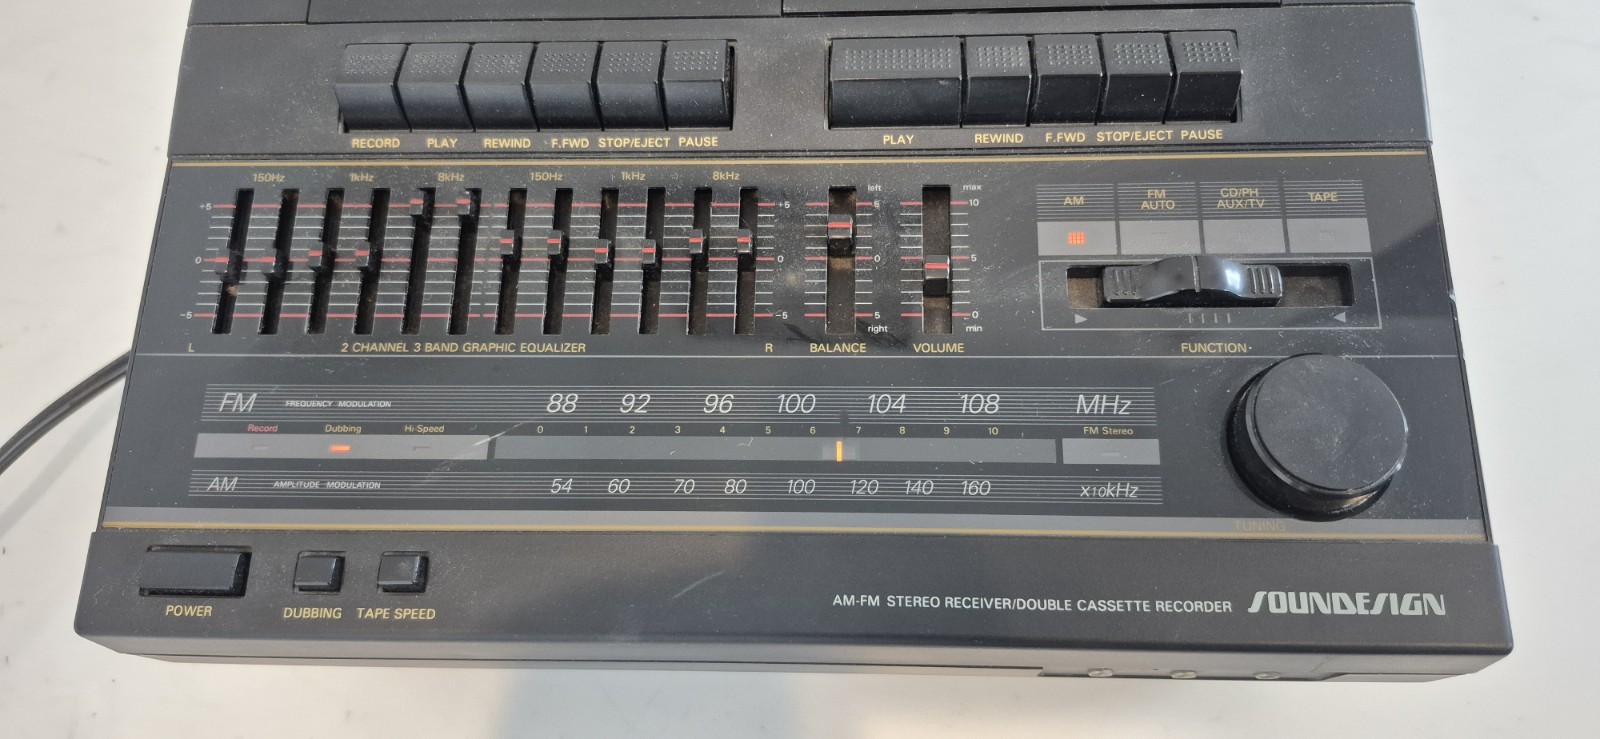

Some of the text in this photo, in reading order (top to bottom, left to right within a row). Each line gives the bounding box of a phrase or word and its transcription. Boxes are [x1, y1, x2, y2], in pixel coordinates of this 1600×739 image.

[882, 134, 914, 145] PLAY
[974, 133, 1024, 144] REWIND
[1045, 132, 1086, 143] F.FWD
[1096, 130, 1173, 142] STOP/EJECT
[1180, 129, 1223, 140] PAUSE
[351, 138, 401, 149] RECORD
[427, 138, 458, 149] PLAY
[483, 138, 531, 149] REWIND
[551, 138, 590, 149] F.FWD
[598, 137, 670, 149] STOP/EJECT
[678, 136, 719, 148] PAUSE
[252, 172, 285, 183] 150Hz
[350, 172, 374, 183] 1kHz
[437, 172, 465, 183] 8kHz
[529, 171, 563, 182] 150Hz
[621, 171, 646, 182] 1kHz
[712, 171, 740, 181] 8kHz
[868, 184, 882, 192] left
[963, 184, 982, 192] max
[1220, 187, 1259, 198] CD/PH
[1147, 189, 1166, 199] FM
[1308, 191, 1338, 202] TAPE
[199, 202, 212, 211] +5
[778, 200, 791, 209] +5
[970, 199, 979, 207] 10
[1064, 196, 1084, 206] AM
[1140, 199, 1175, 210] AUTO
[1216, 199, 1265, 209] AUX/TV
[195, 255, 202, 265] 0
[777, 254, 785, 263] 0
[874, 253, 881, 262] 0
[970, 253, 977, 262] 5
[874, 310, 881, 319] 5
[972, 310, 979, 318] 0
[867, 324, 888, 334] right
[966, 324, 983, 333] min
[188, 343, 195, 352] L
[341, 343, 586, 353] 2 CHANNEL 3 BAND GRAPHIC EQUALIZER
[765, 343, 773, 353] R
[809, 342, 867, 353] BALANCE
[913, 342, 964, 353] VOLUME
[1181, 342, 1247, 353] FUNCTION
[219, 393, 257, 412] FM
[285, 400, 392, 408] FREQUENCY MODULATION
[546, 393, 578, 413] 88
[619, 394, 650, 413] 92
[703, 394, 734, 413] 96
[776, 394, 816, 414] 100
[867, 394, 906, 413] 104
[960, 394, 1000, 414] 108
[1076, 394, 1132, 415] MHz
[247, 424, 278, 433] Record
[325, 424, 362, 434] Dubbing
[537, 426, 543, 435] 0
[629, 426, 635, 435] 2
[675, 426, 681, 435] 3
[719, 426, 726, 434] 4
[765, 426, 771, 435] 5
[809, 427, 816, 436] 6
[856, 427, 861, 436] 7
[900, 427, 906, 436] 8
[943, 427, 950, 436] 9
[988, 427, 998, 436] 10
[1083, 427, 1134, 435] FM Stereo
[206, 476, 238, 492] AM
[273, 481, 381, 489] AMPLITUDE MODULATION
[550, 478, 573, 494] 54
[608, 478, 631, 494] 60
[675, 478, 695, 494] 70
[724, 478, 747, 494] 80
[788, 479, 816, 495] 100
[850, 479, 879, 495] 120
[904, 479, 934, 495] 140
[961, 479, 991, 496] 160
[1234, 520, 1286, 531] TUNING
[832, 594, 1232, 613] AM-FM STEREO RECEIVER/DOUBLE CASSETTE RECORDER
[1248, 591, 1446, 616] SOUNDESIGN
[165, 605, 212, 617] POWER
[283, 607, 342, 619] DUBBING
[357, 608, 436, 620] TAPE SPEED
